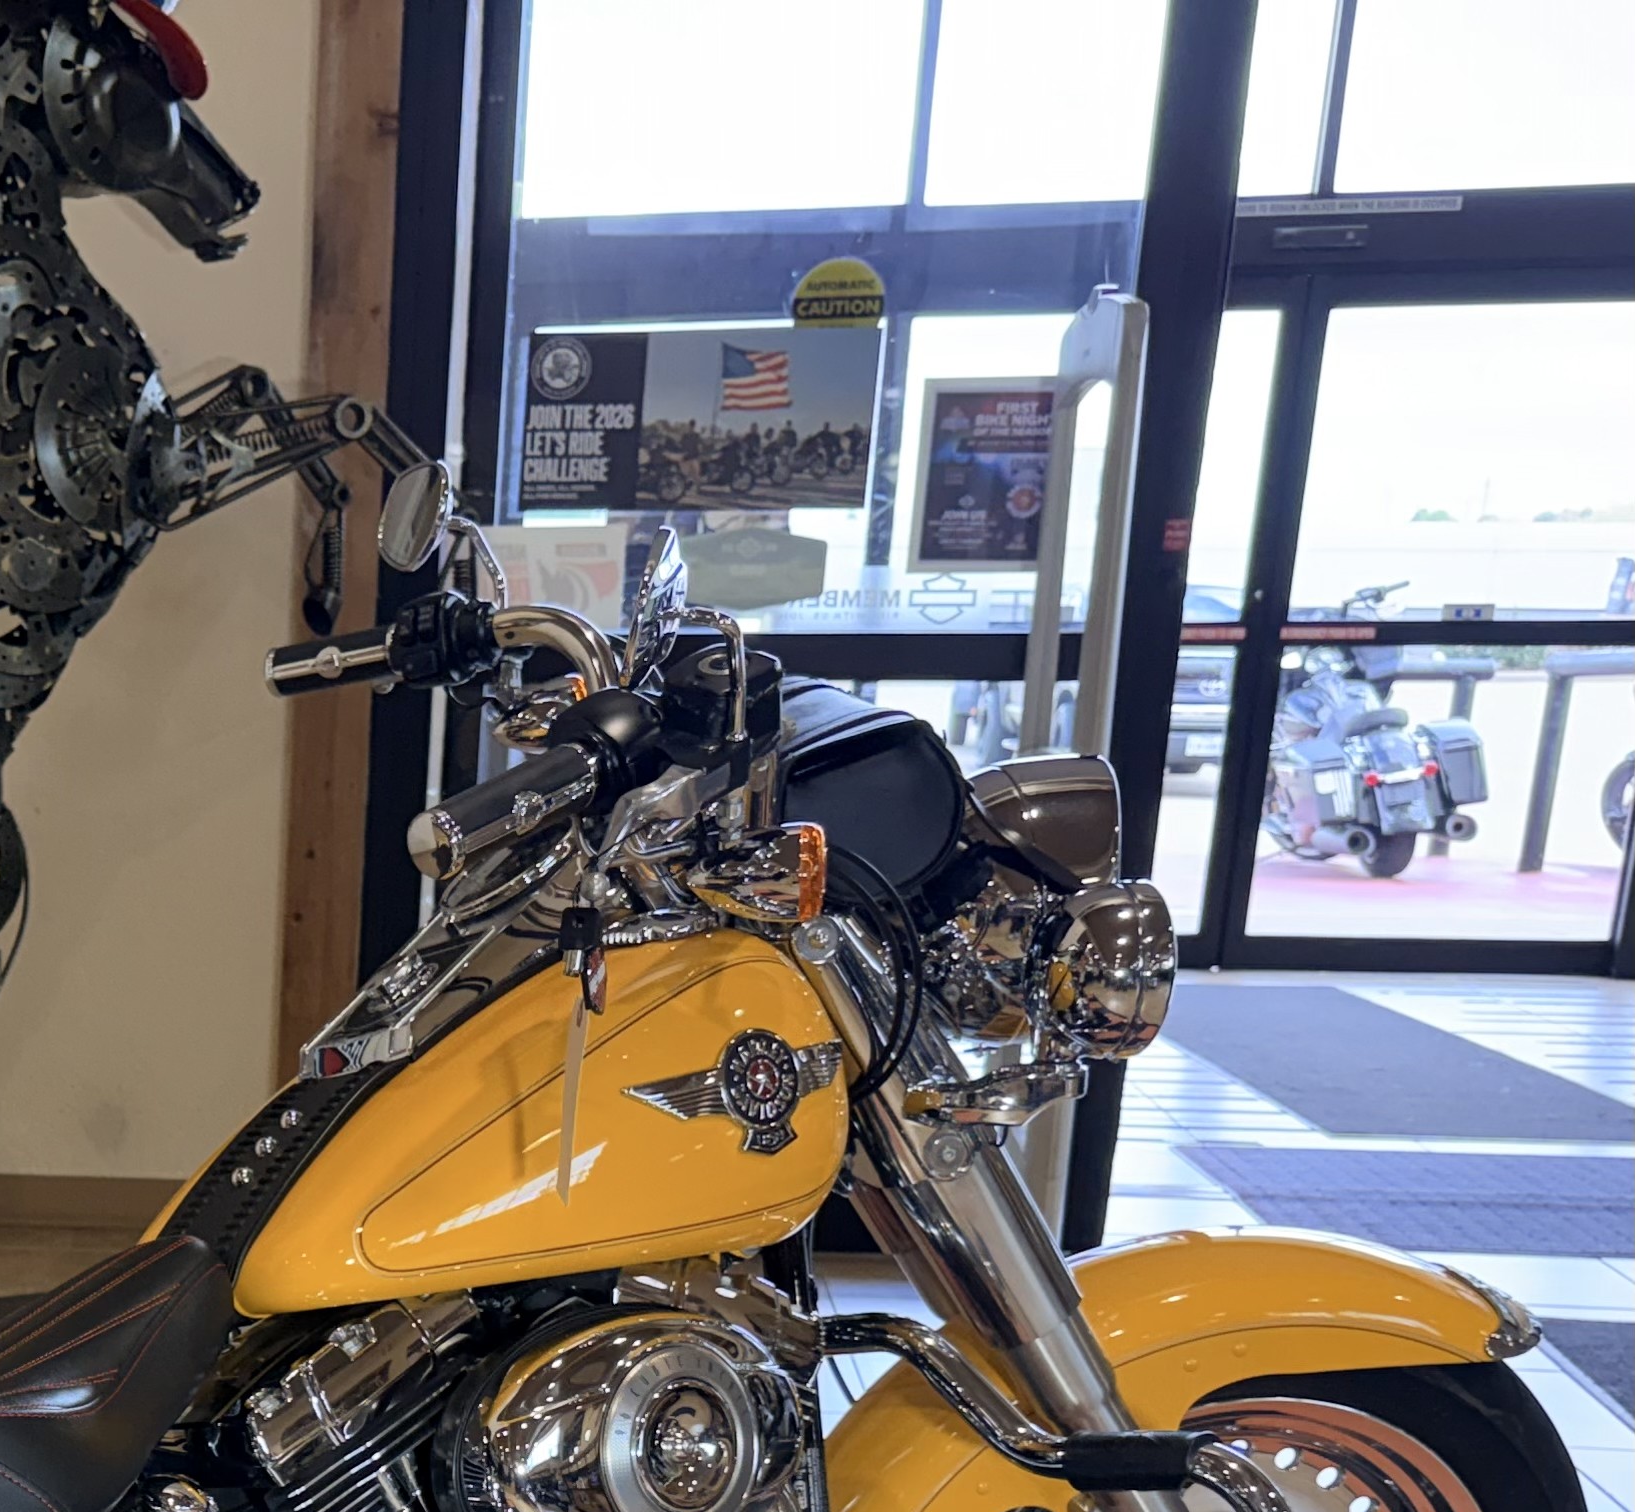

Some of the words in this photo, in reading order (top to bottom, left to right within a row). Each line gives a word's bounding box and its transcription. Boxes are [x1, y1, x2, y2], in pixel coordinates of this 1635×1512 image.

[806, 280, 875, 291] AUTOMATIC
[796, 299, 880, 317] CAUTION
[527, 405, 563, 429] JOIN
[564, 404, 593, 429] THE
[594, 404, 635, 429] 2026
[996, 402, 1039, 414] FIRST
[975, 414, 1008, 426] BIKE
[525, 431, 566, 456] LET'S
[568, 431, 605, 455] RIDE
[524, 457, 611, 482] CHALLENGE
